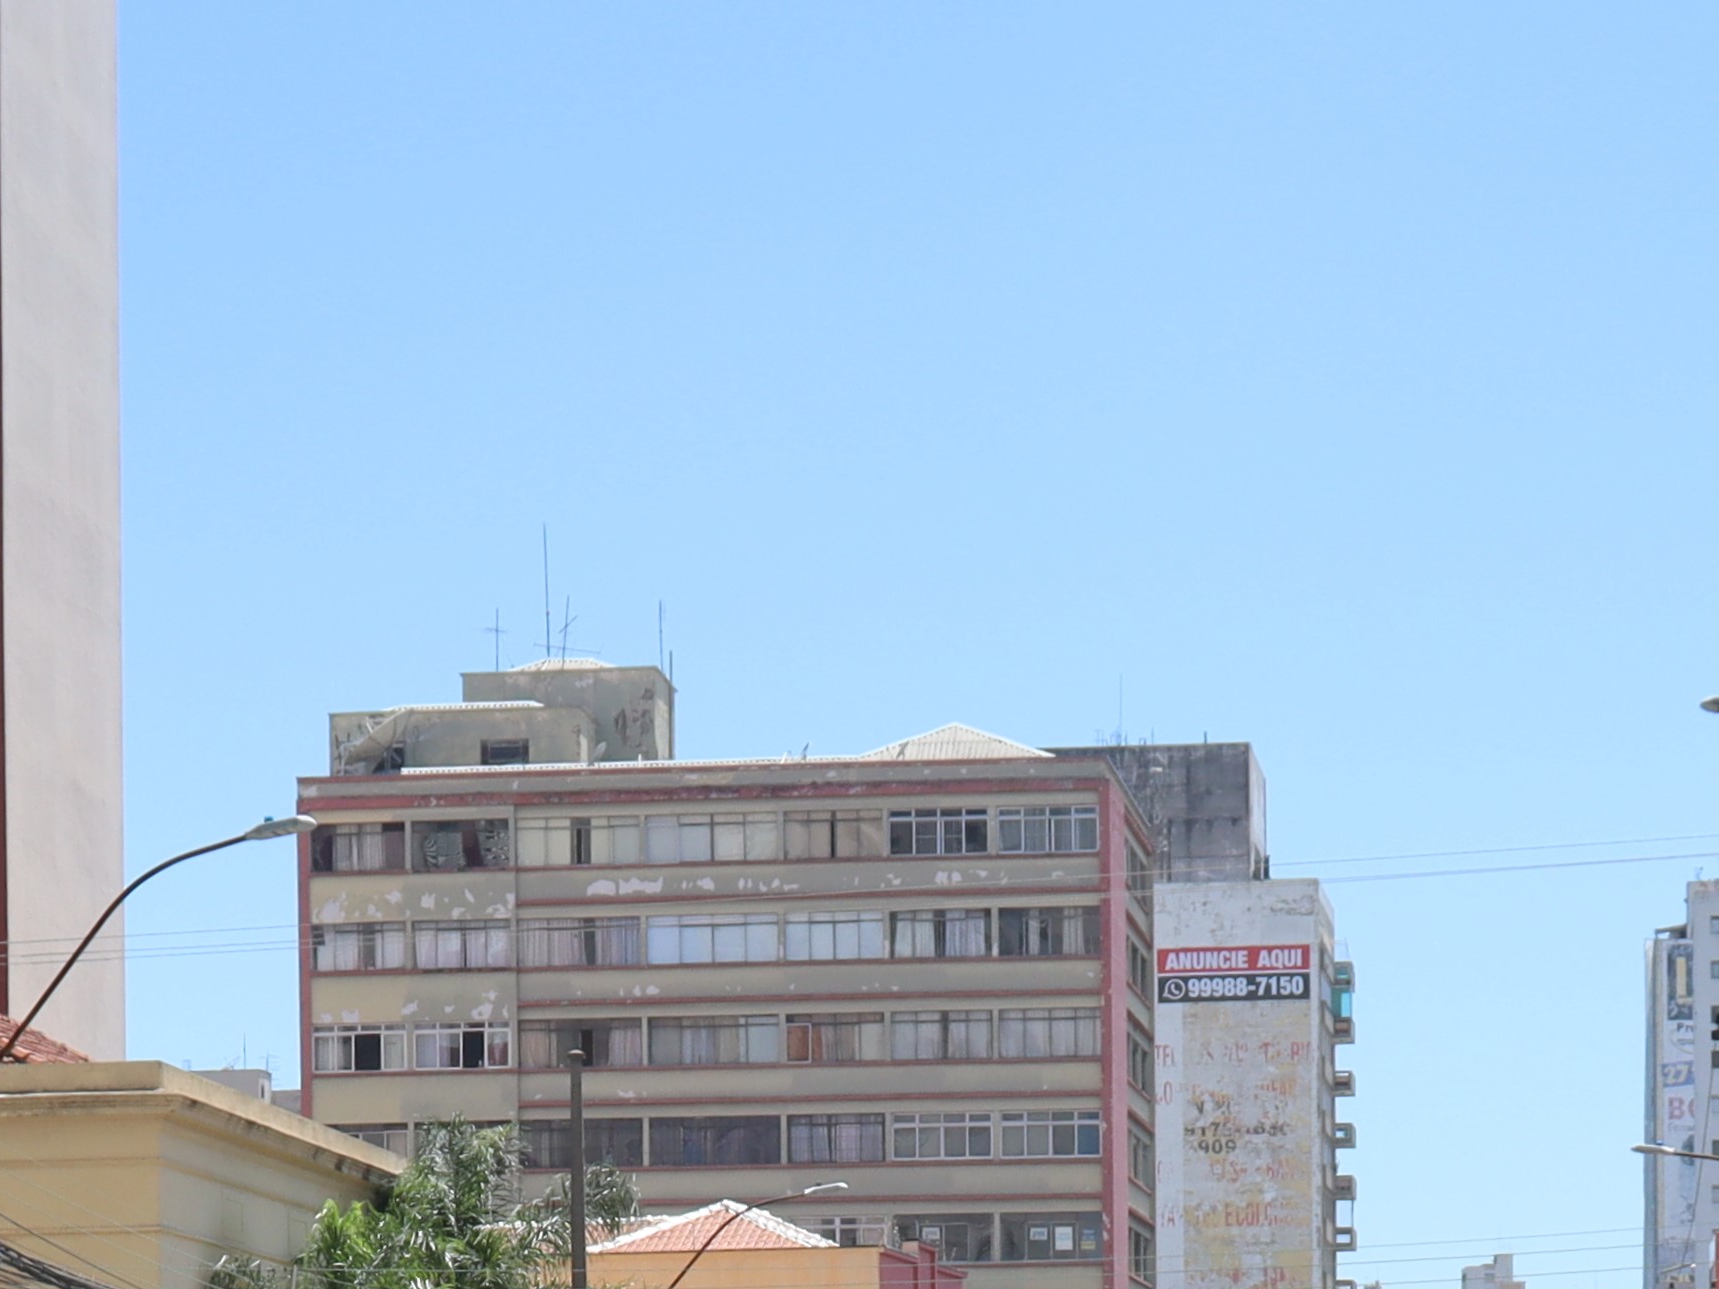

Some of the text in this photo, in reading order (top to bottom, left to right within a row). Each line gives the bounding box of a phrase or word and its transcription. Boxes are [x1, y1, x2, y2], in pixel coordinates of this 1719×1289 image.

[1165, 948, 1303, 971] ANUNCIE AQUI
[1187, 975, 1304, 998] 99988-7150
